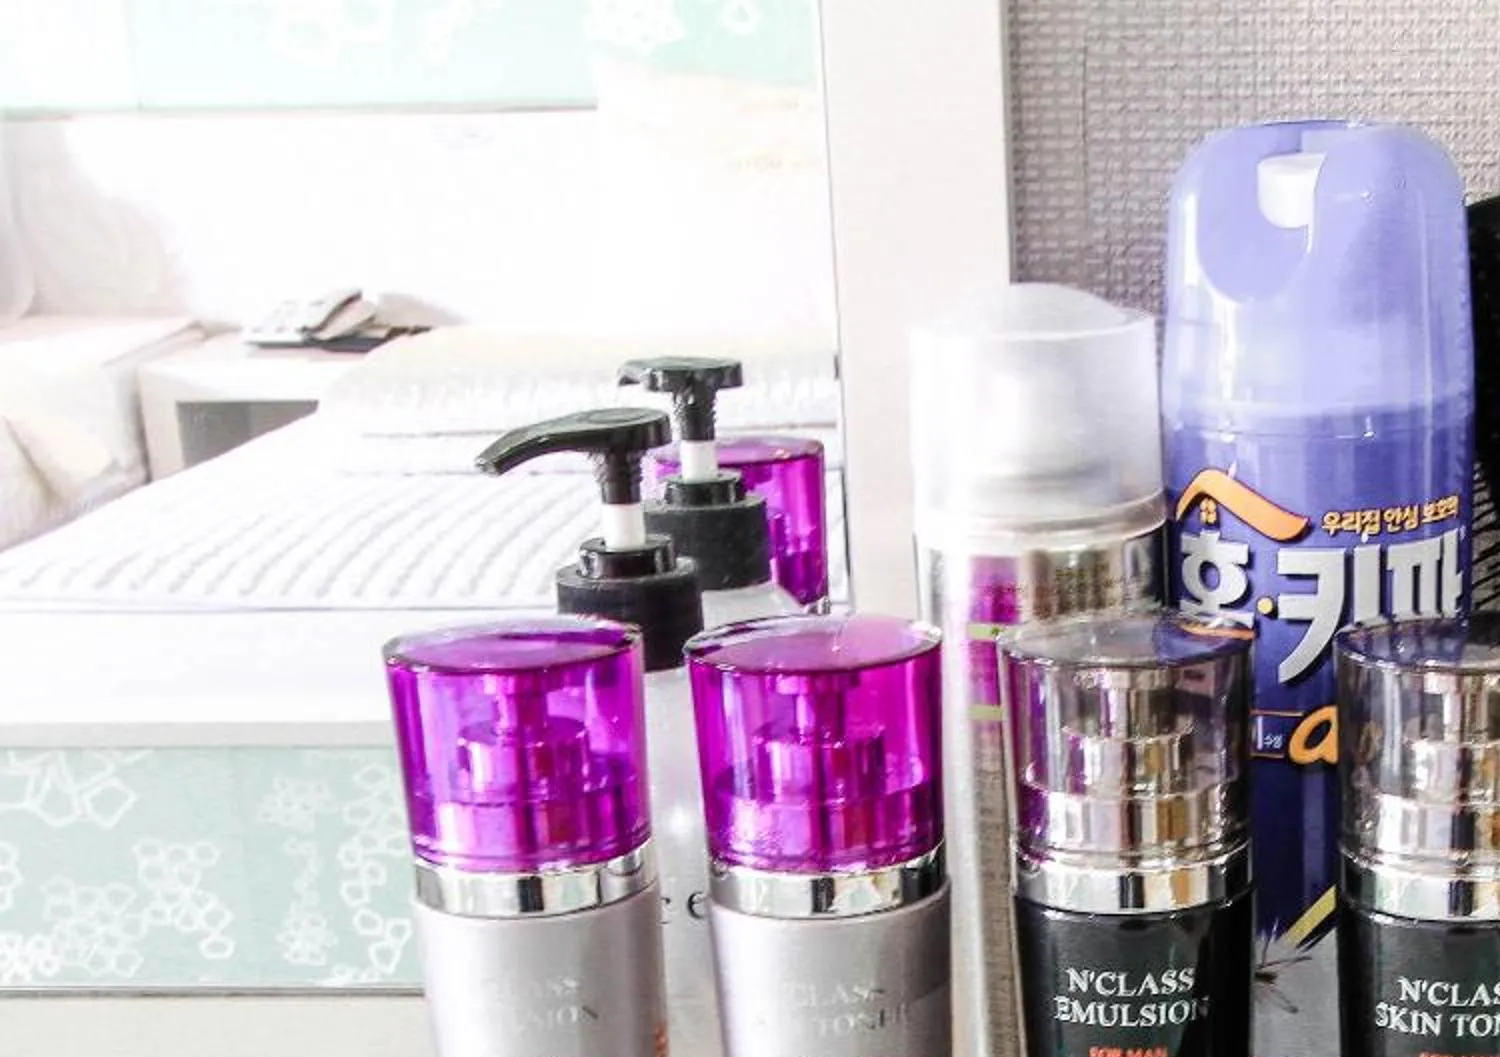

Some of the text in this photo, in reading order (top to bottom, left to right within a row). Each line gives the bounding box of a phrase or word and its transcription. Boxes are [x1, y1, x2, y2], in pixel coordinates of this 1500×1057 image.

[1322, 508, 1381, 535] 우리집
[1065, 967, 1196, 996] N'CLASS
[1375, 1001, 1443, 1037] SKIN
